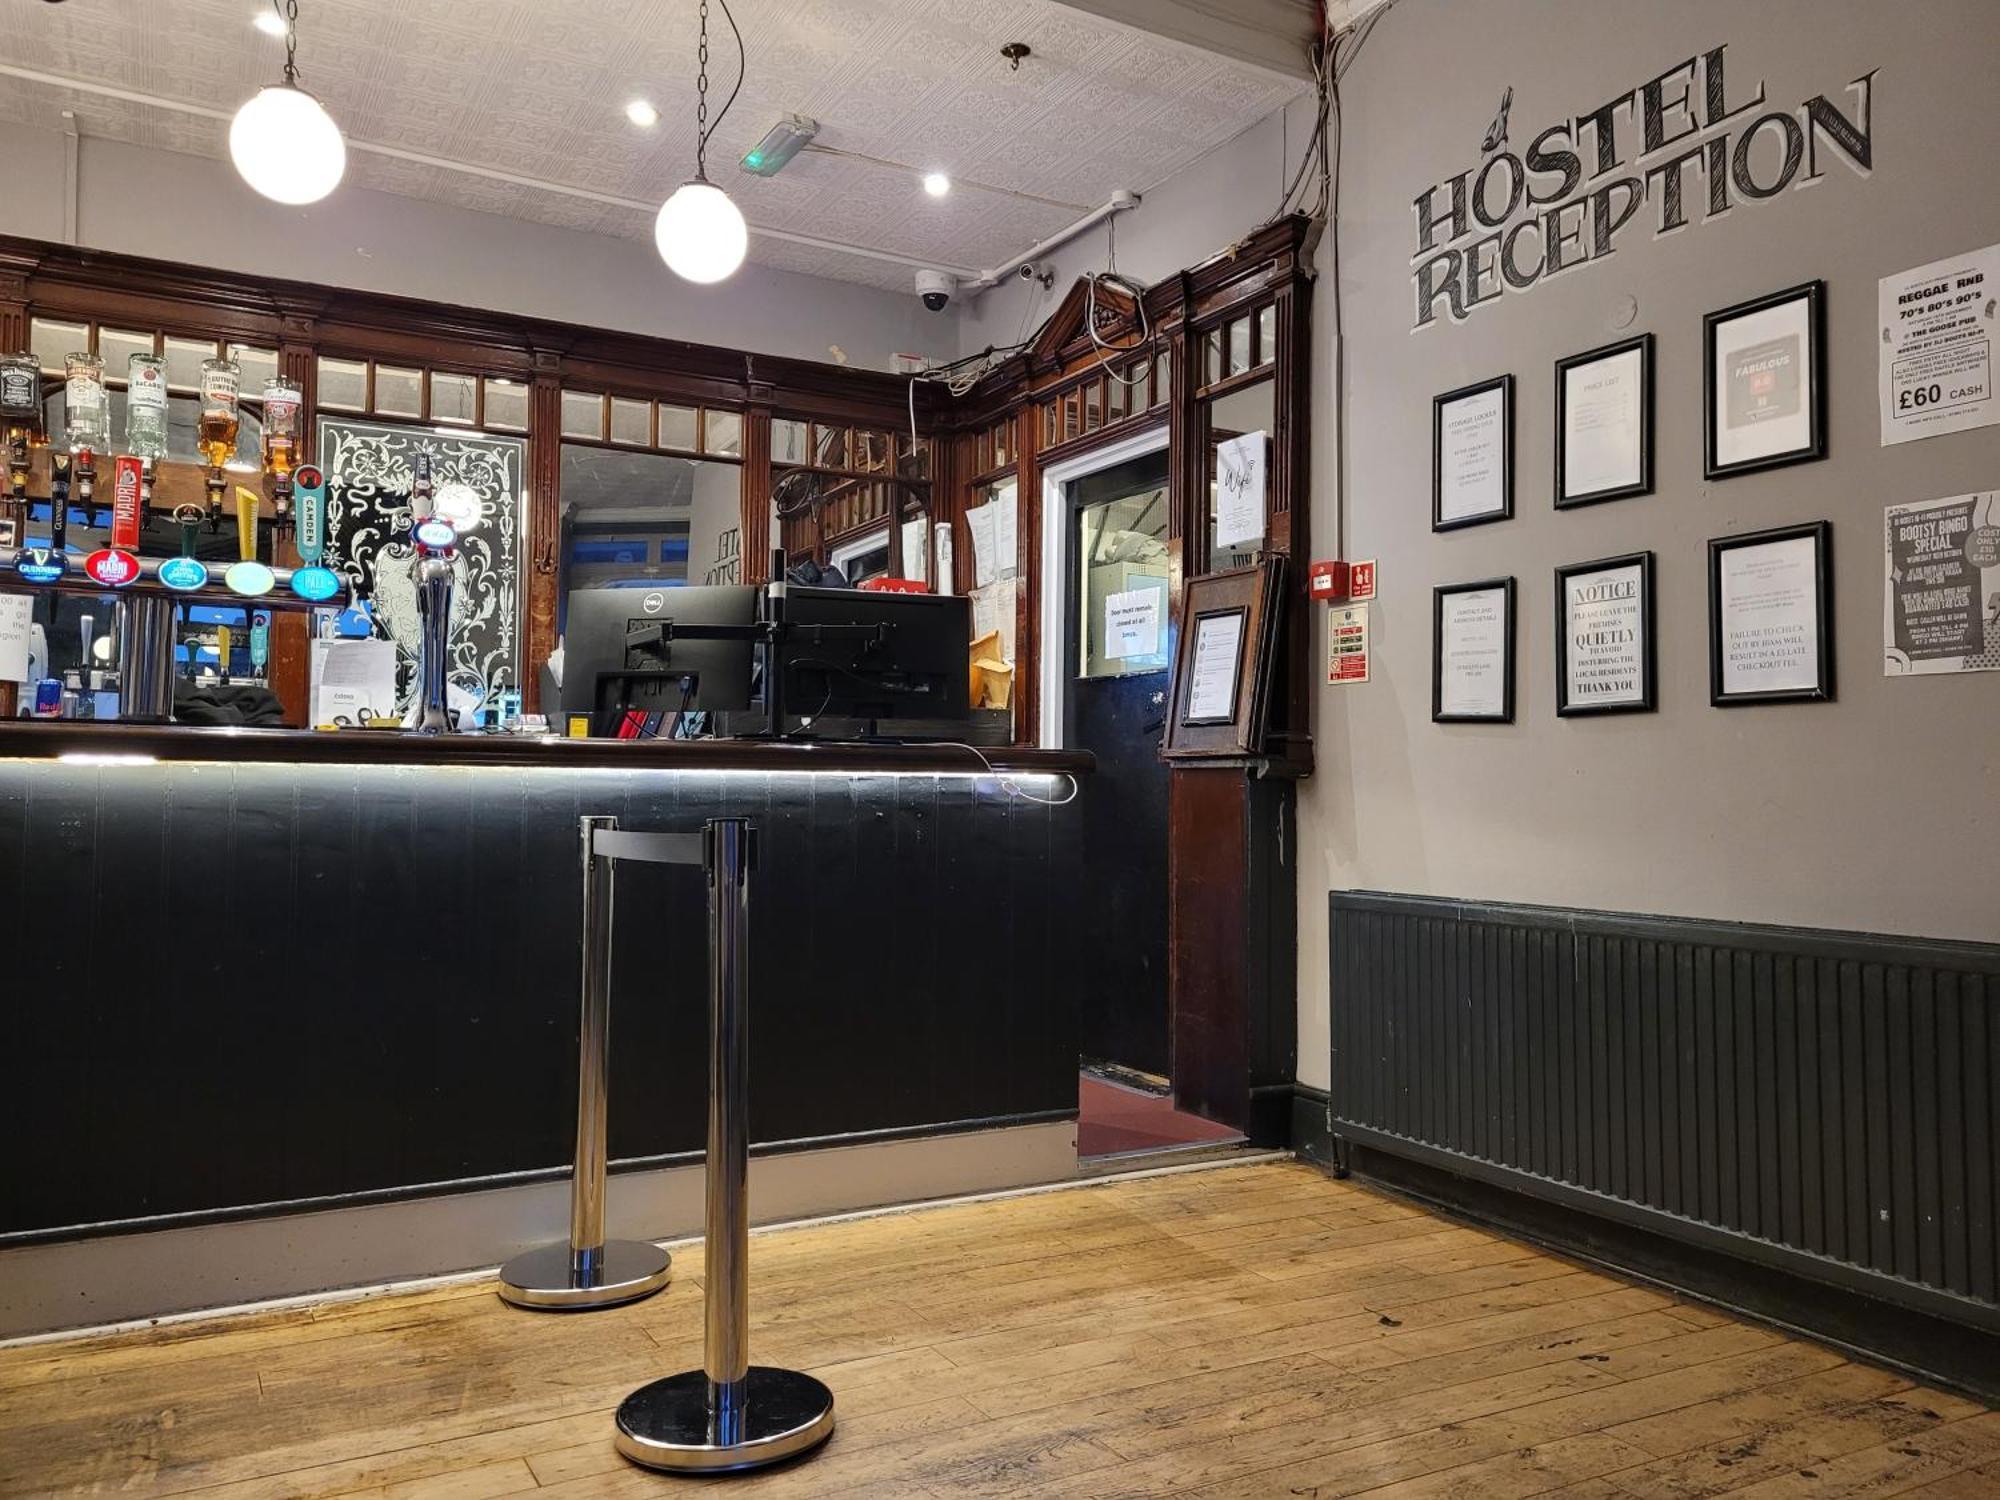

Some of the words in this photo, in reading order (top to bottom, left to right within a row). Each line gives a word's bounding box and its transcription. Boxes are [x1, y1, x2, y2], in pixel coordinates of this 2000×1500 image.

[1411, 44, 1766, 259] HOSTEL
[1411, 66, 1881, 329] RECEPTION
[1898, 283, 1949, 305] REGGAE
[1956, 273, 1984, 289] RNB
[1912, 329, 1927, 338] THE
[1929, 321, 1957, 334] GOOSE
[1958, 316, 1977, 326] PUB
[1735, 355, 1791, 378] FABULOUS
[1900, 384, 1941, 410] £60
[1949, 385, 1983, 399] CASH
[305, 499, 315, 544] CAMDEN
[1900, 521, 1936, 542] BOOTSY
[1939, 516, 1968, 535] BINGO
[1914, 534, 1953, 554] SPECIAL
[1575, 580, 1636, 603] NOTICE
[1576, 628, 1635, 650] QUIETLY
[1730, 629, 1760, 640] FAILURE
[1763, 628, 1774, 636] TO
[1775, 625, 1804, 635] CHECK
[1732, 641, 1749, 650] OUT
[1750, 640, 1760, 649] BY
[1783, 636, 1802, 645] WILL
[1578, 657, 1620, 668] DISTURBING
[1730, 651, 1757, 662] RESULT
[1786, 647, 1806, 657] LATE
[1736, 659, 1781, 672] CHECKOUT
[1575, 669, 1597, 679] LOCAL
[1598, 666, 1637, 677] RESIDENTS
[1577, 682, 1613, 694] THANK
[1613, 680, 1635, 691] YOU
